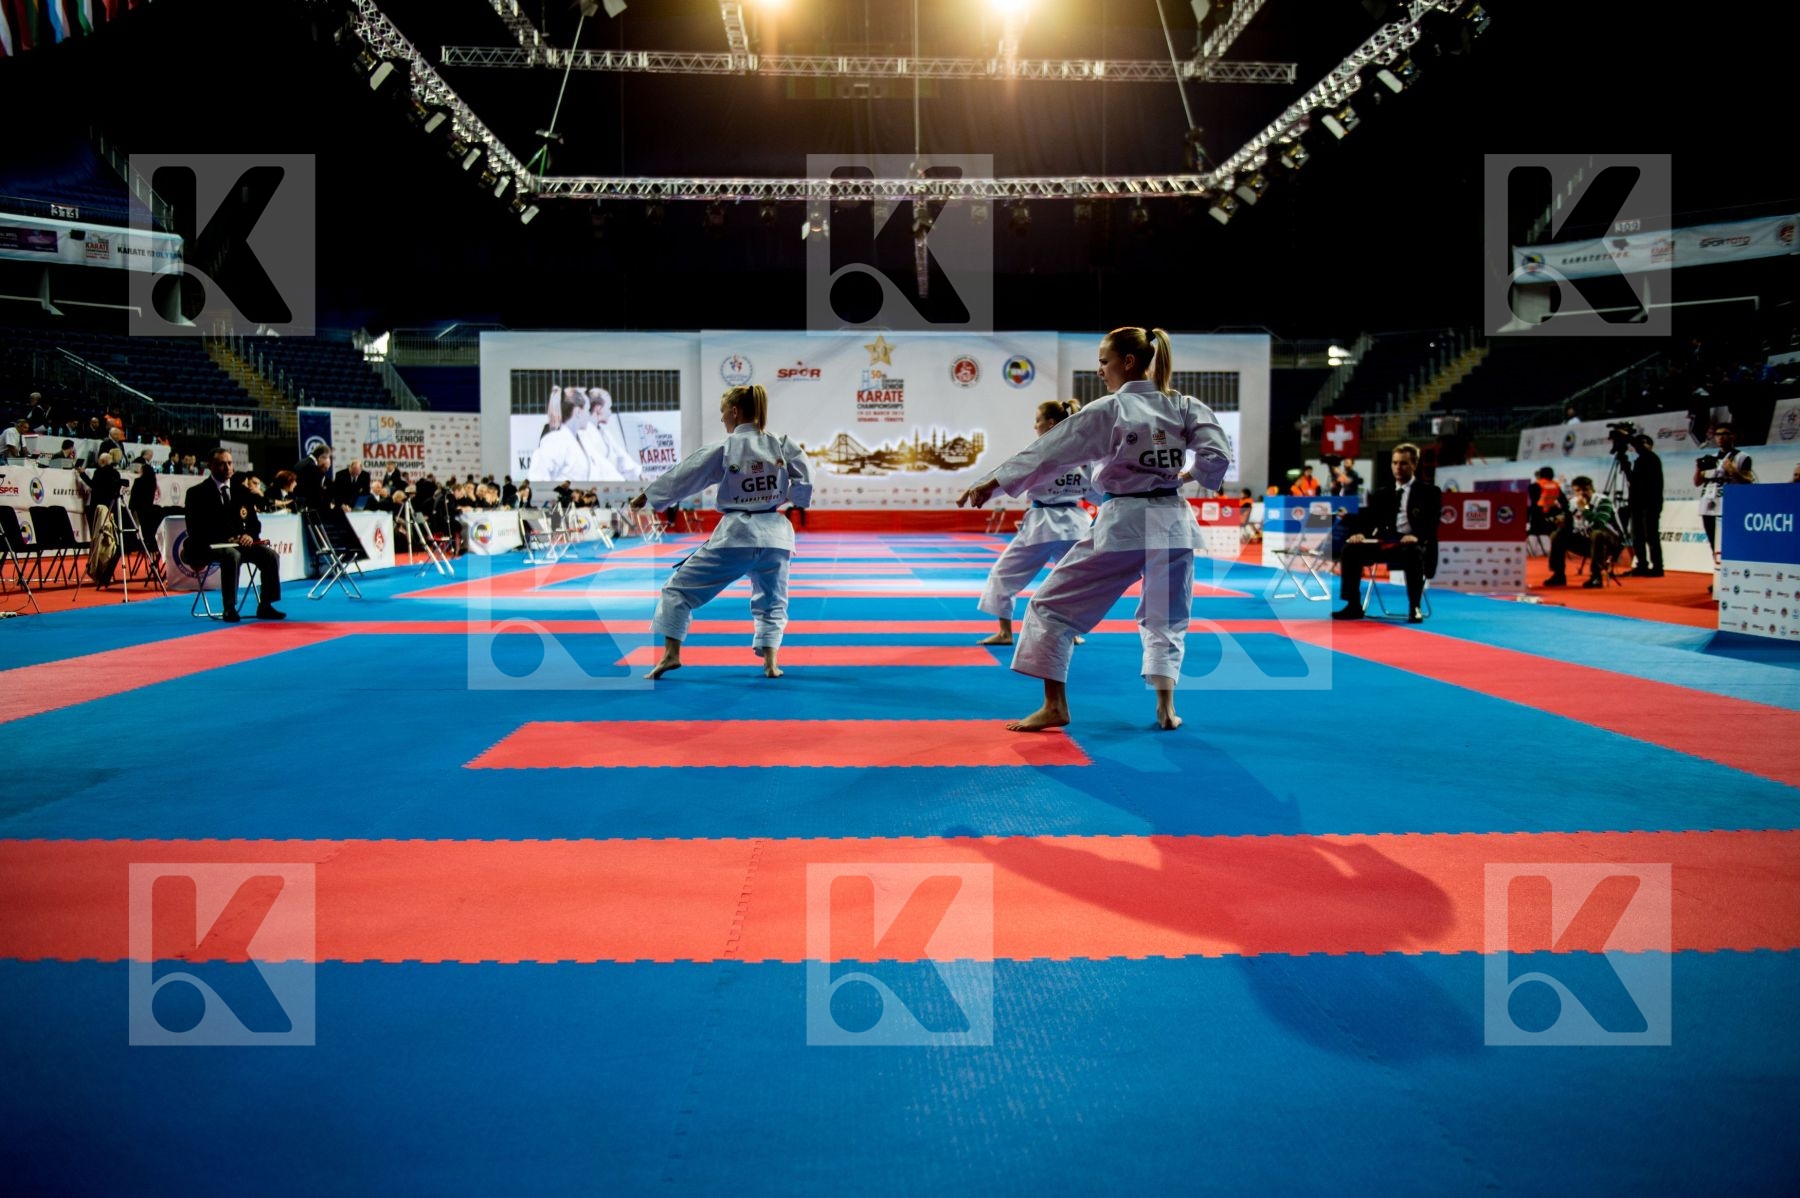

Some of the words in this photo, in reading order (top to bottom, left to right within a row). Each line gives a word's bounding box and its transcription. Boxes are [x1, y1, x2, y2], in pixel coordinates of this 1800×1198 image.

[117, 246, 146, 257] KARATE
[857, 390, 904, 402] KARATE
[225, 416, 251, 430] 114
[380, 416, 402, 428] 50th
[395, 435, 425, 443] SENIOR
[363, 443, 425, 459] KARATE
[639, 448, 677, 464] KARATE
[1139, 448, 1183, 468] GER
[741, 475, 778, 493] GER
[1055, 474, 1081, 487] GER
[1744, 513, 1793, 532] COACH
